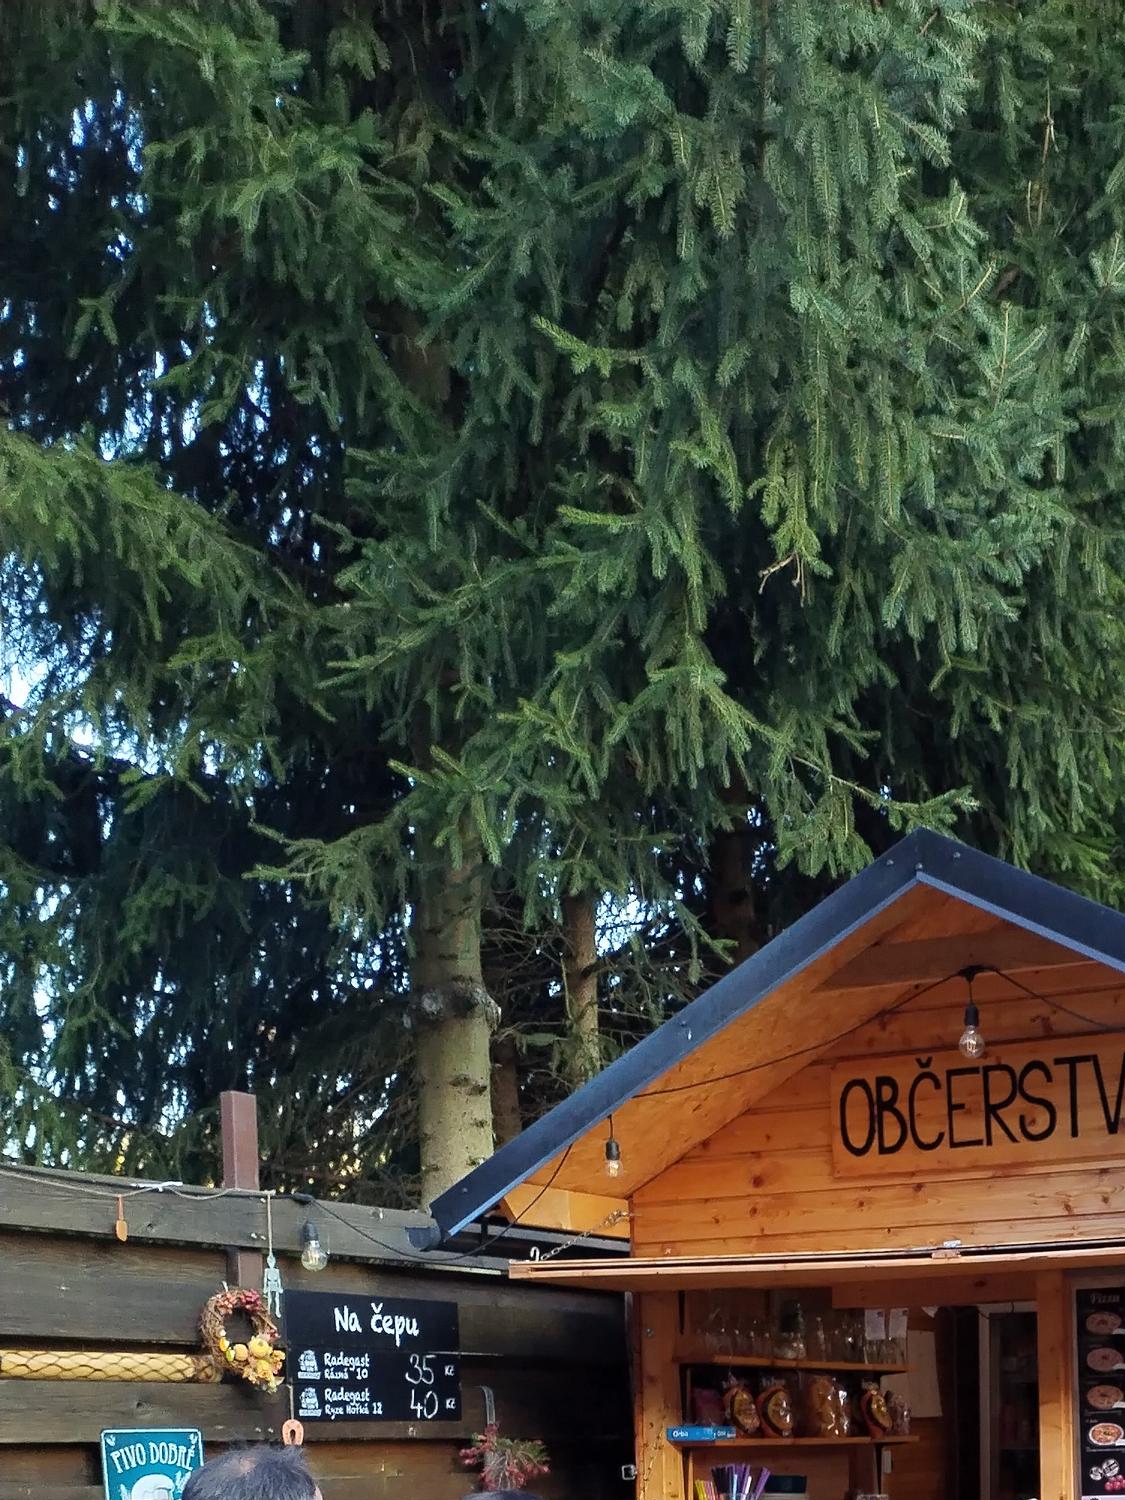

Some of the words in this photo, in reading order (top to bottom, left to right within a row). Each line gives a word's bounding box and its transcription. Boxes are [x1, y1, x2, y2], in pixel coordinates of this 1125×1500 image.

[334, 1305, 362, 1333] Na
[370, 1302, 419, 1347] čepu
[324, 1351, 370, 1371] Radegast
[405, 1353, 436, 1385] 35
[444, 1365, 455, 1377] Kč
[356, 1369, 369, 1380] 10
[324, 1386, 370, 1406] Radegast
[372, 1402, 383, 1415] 12
[410, 1389, 438, 1419] 40
[446, 1398, 456, 1410] Kč
[110, 1442, 147, 1474] PIVO
[149, 1441, 195, 1471] DOBRÉ
